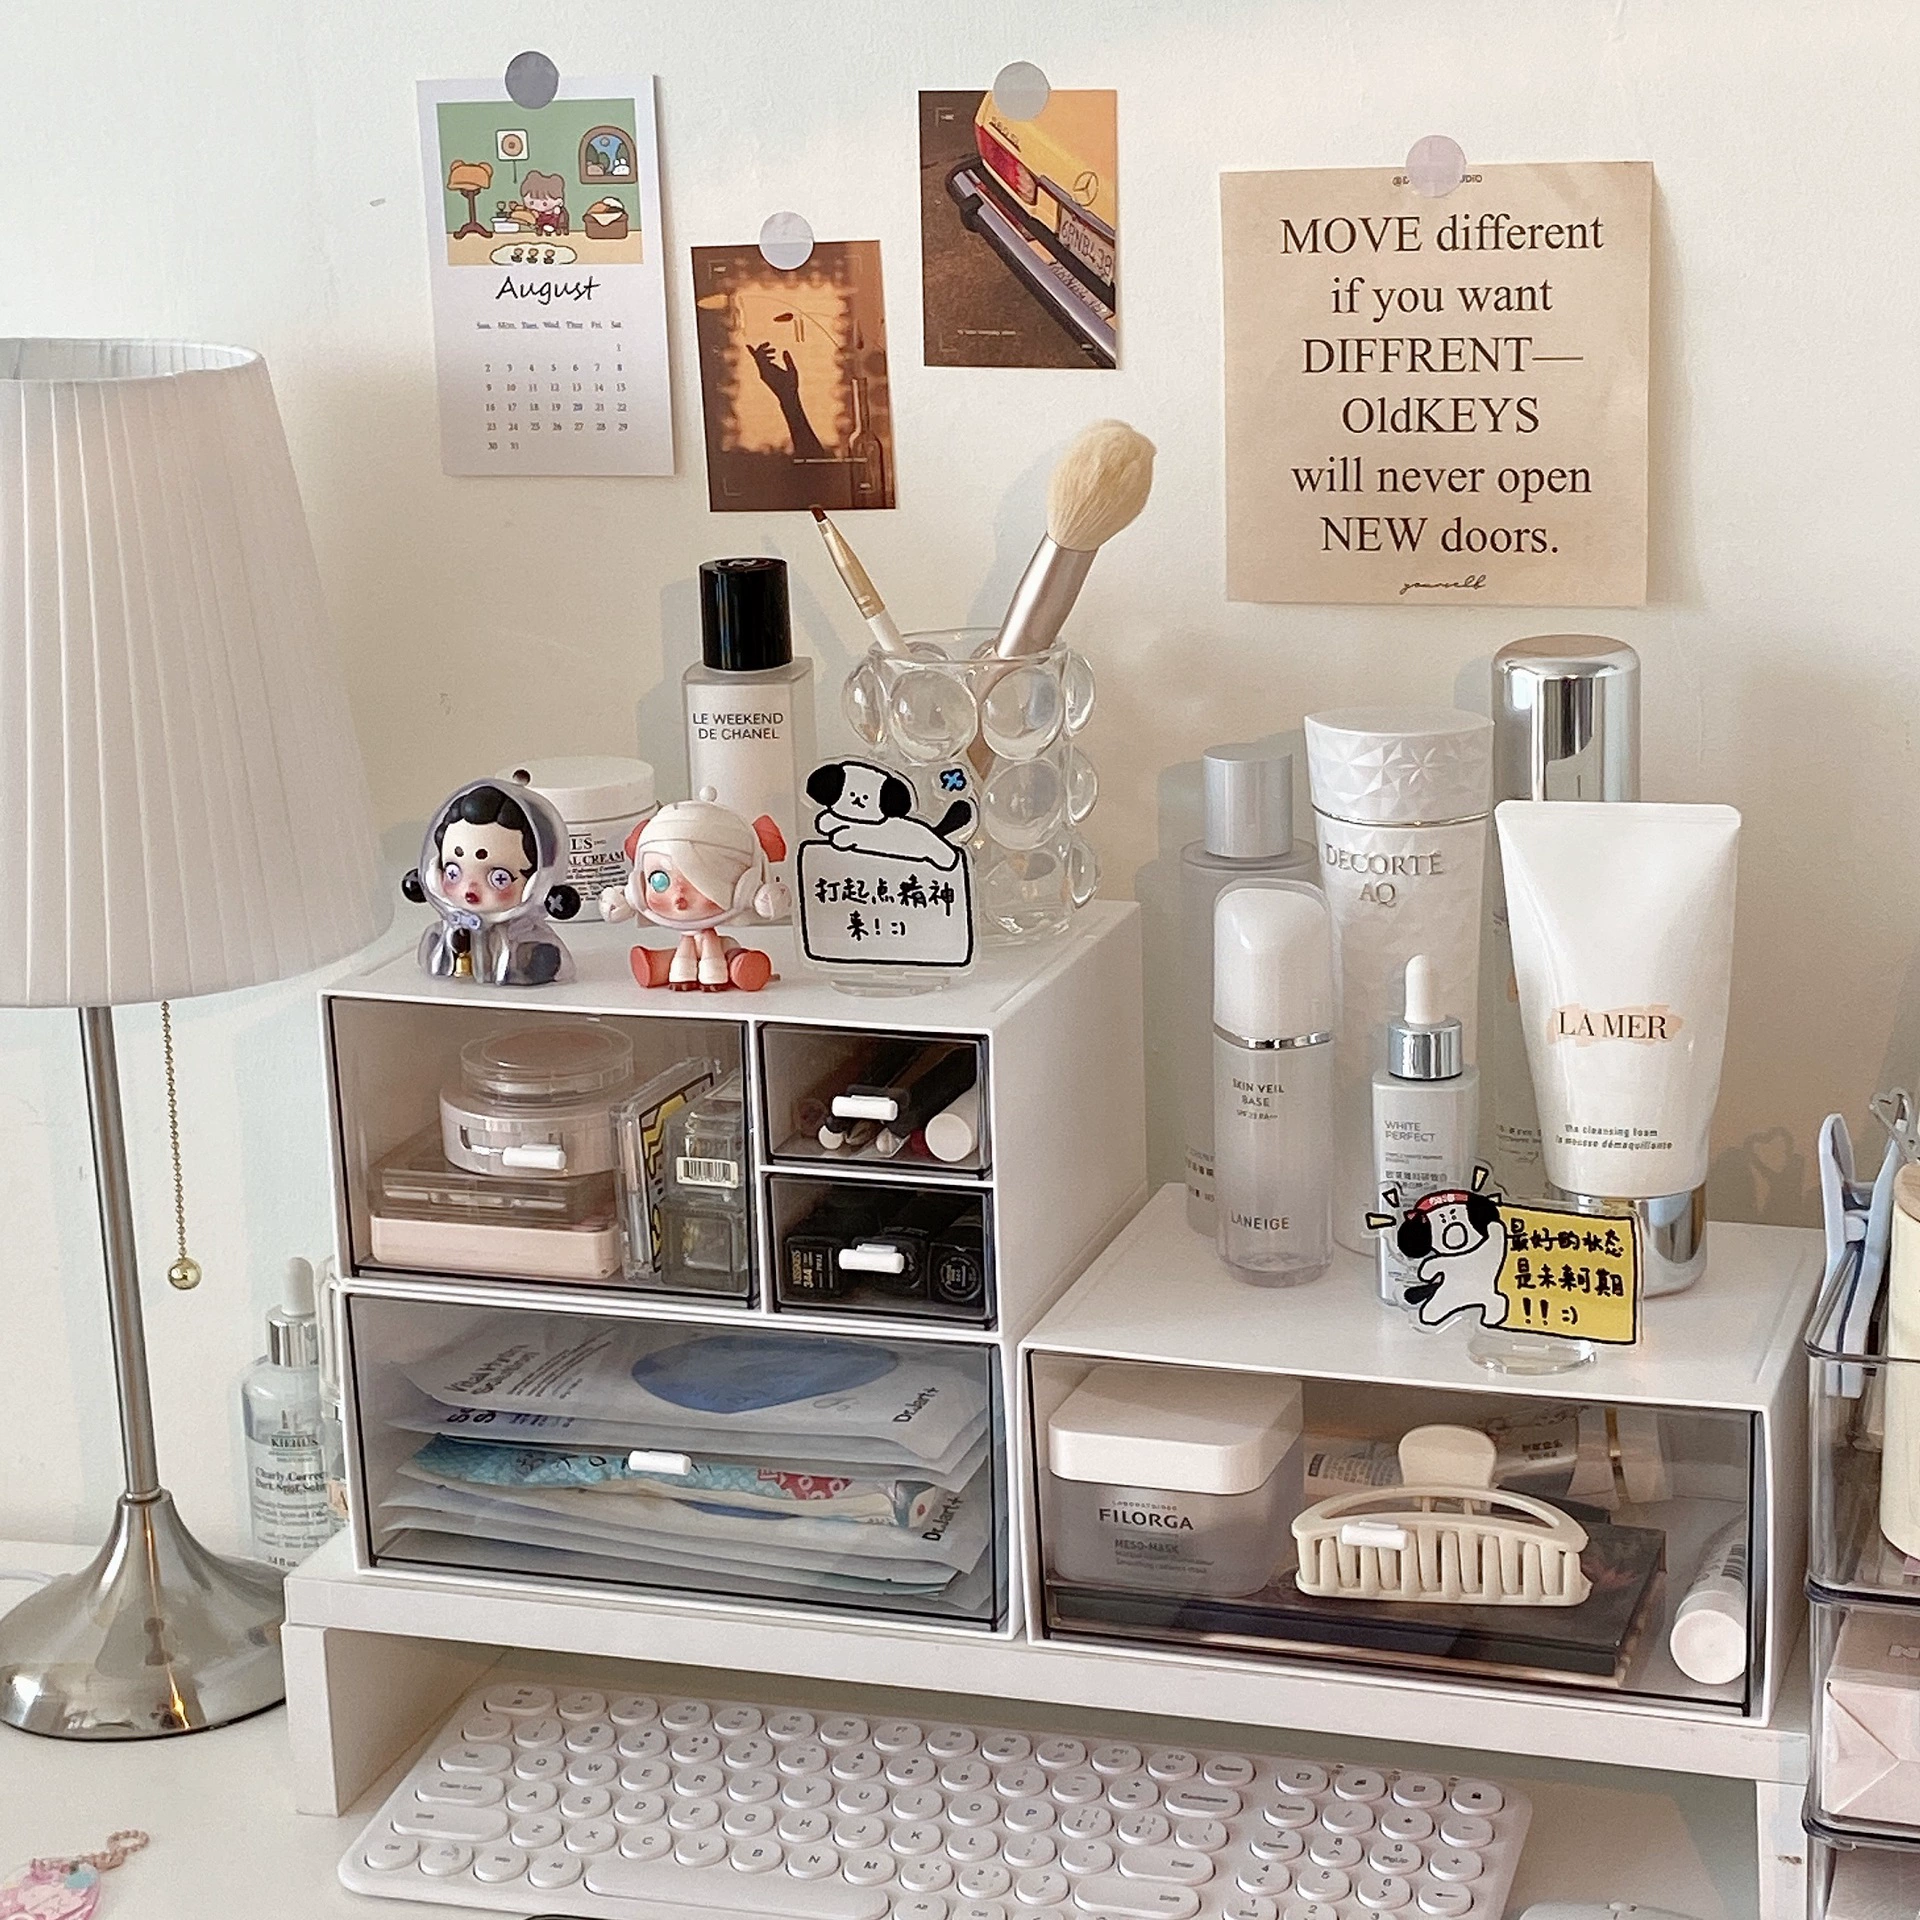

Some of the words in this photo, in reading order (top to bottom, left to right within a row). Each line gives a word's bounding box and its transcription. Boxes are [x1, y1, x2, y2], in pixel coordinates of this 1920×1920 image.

[1280, 217, 1421, 254] MOVE
[1437, 212, 1604, 252] different
[495, 275, 601, 306] August
[1331, 277, 1364, 314] if
[1372, 288, 1444, 323] you
[1457, 279, 1553, 311] want
[485, 364, 491, 372] 2
[507, 364, 513, 372] 3
[529, 364, 535, 372] 4
[551, 364, 557, 372] 5
[573, 364, 579, 372] 6
[595, 364, 600, 372] 7
[617, 364, 622, 372] 8
[486, 384, 492, 392] 9
[507, 384, 516, 392] 10
[529, 384, 537, 392] 11
[551, 384, 560, 392] 12
[572, 384, 582, 392] 13
[595, 384, 604, 392] 14
[616, 384, 626, 392] 15
[486, 403, 495, 412] 16
[508, 403, 517, 412] 17
[530, 403, 539, 412] 18
[552, 403, 561, 412] 19
[573, 403, 583, 412] 20
[595, 403, 604, 412] 21
[617, 403, 627, 412] 22
[1342, 397, 1539, 433] OldKEYS
[487, 423, 496, 431] 23
[508, 423, 518, 431] 24
[531, 423, 540, 431] 25
[553, 423, 562, 431] 26
[574, 423, 584, 431] 27
[596, 423, 606, 431] 28
[618, 423, 628, 431] 29
[488, 442, 498, 450] 30
[1291, 456, 1363, 492] will
[1376, 467, 1485, 493] never
[1497, 467, 1592, 503] open
[1319, 517, 1428, 552] NEW
[1440, 517, 1559, 553] doors.
[693, 713, 708, 724] LE
[713, 713, 784, 725] WEEKEND
[698, 728, 717, 739] DE
[721, 728, 780, 740] CHANEL
[815, 874, 954, 916] 打起点精神
[1359, 883, 1396, 908] AQ
[1559, 1011, 1595, 1036] LA
[1602, 1013, 1668, 1039] MER
[1257, 1084, 1285, 1094] VEIL
[1242, 1095, 1270, 1107] BASE
[1385, 1121, 1420, 1131] WHITE
[1582, 1126, 1630, 1138] cleansing
[1386, 1131, 1435, 1142] PERFECT
[1565, 1138, 1599, 1147] mousse
[1601, 1139, 1673, 1151] démaquillante
[1231, 1210, 1290, 1230] LANEIGE
[1508, 1217, 1624, 1257] 最好的状态
[1515, 1258, 1624, 1297] 是未来可期
[1099, 1508, 1194, 1530] FILORGA
